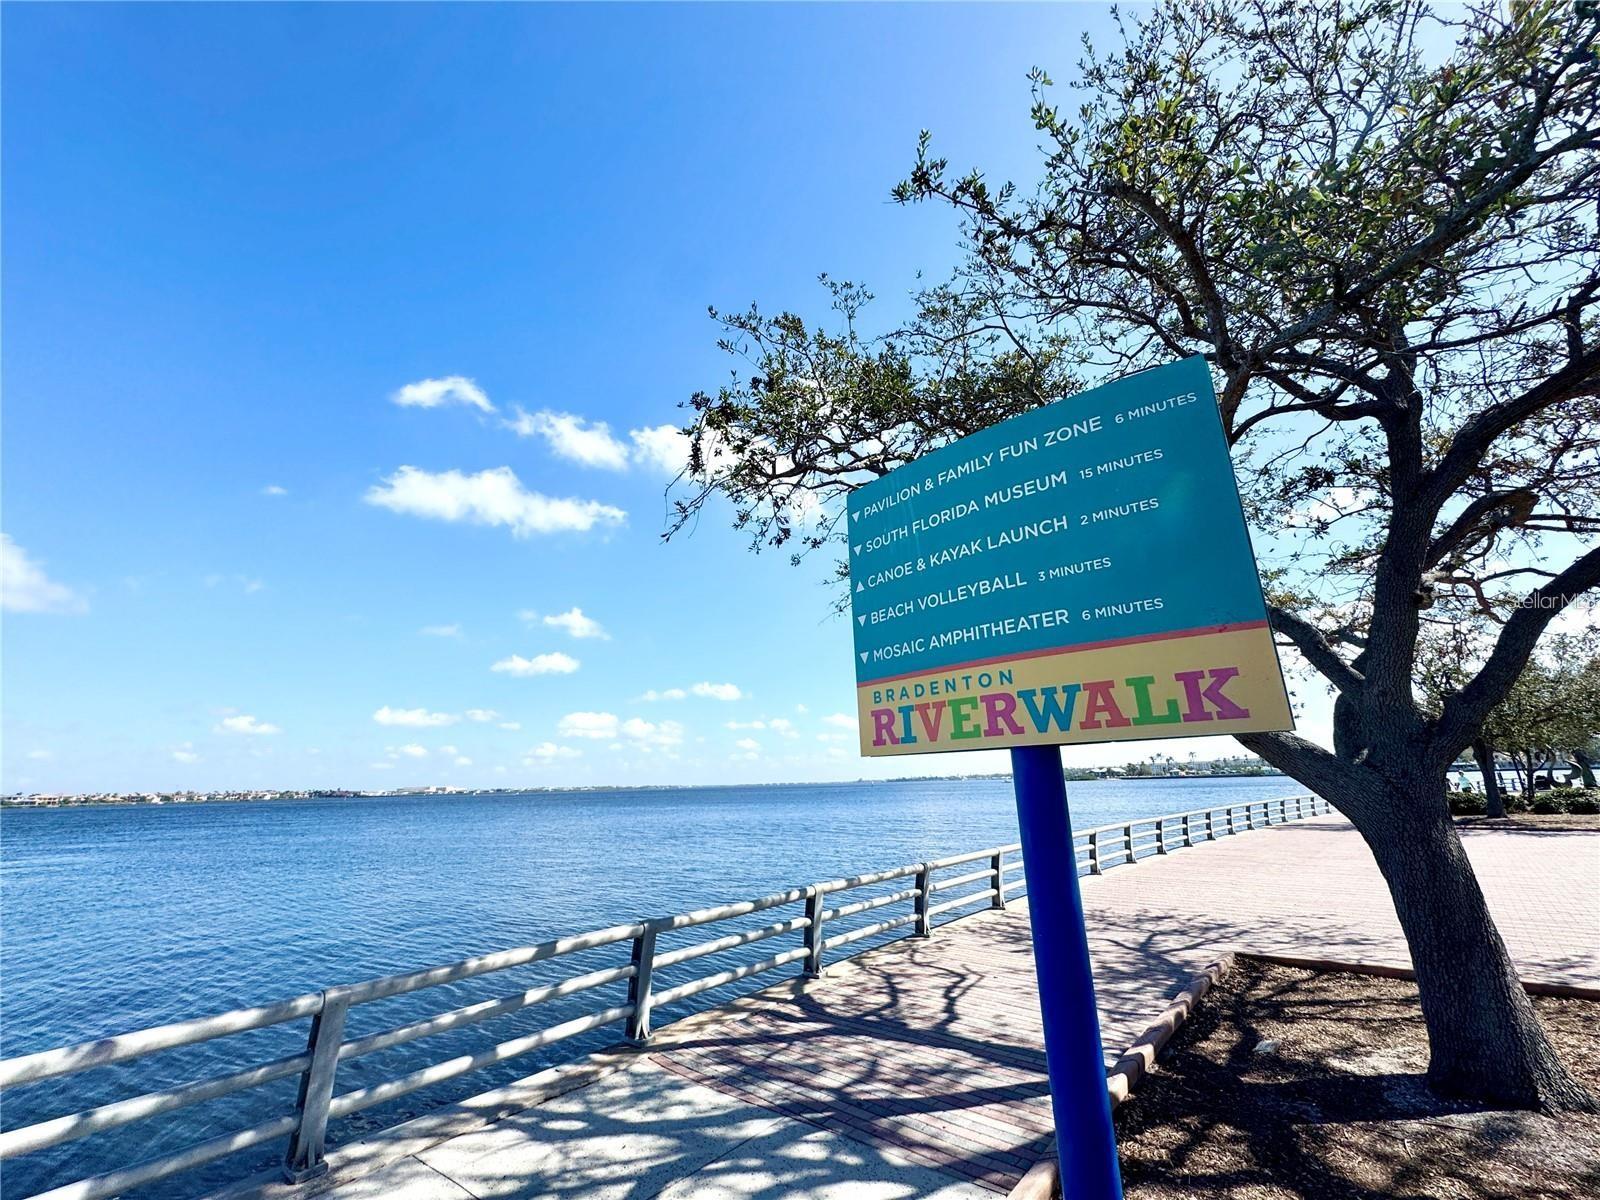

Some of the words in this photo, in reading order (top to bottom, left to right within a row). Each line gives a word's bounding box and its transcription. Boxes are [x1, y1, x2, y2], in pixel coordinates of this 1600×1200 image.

[864, 482, 921, 518] PAVILION
[924, 478, 934, 491] &
[938, 452, 994, 486] FAMILY
[999, 437, 1038, 461] FUN
[1044, 416, 1103, 447] ZONE
[1114, 413, 1124, 424] 6
[1128, 392, 1197, 420] MINUTES
[866, 525, 908, 552] SOUTH
[912, 500, 980, 534] FLORIDA
[984, 470, 1068, 508] MUSEUM
[1079, 467, 1093, 479] 15
[1097, 448, 1164, 475] MINUTES
[867, 562, 913, 587] CANOE
[916, 558, 926, 570] &
[930, 538, 982, 566] KAYAK
[987, 515, 1068, 549] LAUNCH
[1080, 515, 1089, 525] 2
[1092, 498, 1159, 522] MINUTES
[870, 601, 914, 624] BEACH
[917, 572, 1027, 610] VOLLEYBALL
[1038, 571, 1046, 581] 3
[1050, 557, 1112, 579] MINUTES
[873, 638, 925, 662] MOSAIC
[928, 609, 1070, 649] AMPHITHEATER
[1082, 610, 1091, 621] 6
[1094, 598, 1164, 618] MINUTES
[871, 667, 1250, 746] RIVERWALK
[873, 669, 1014, 704] BRADENTON
